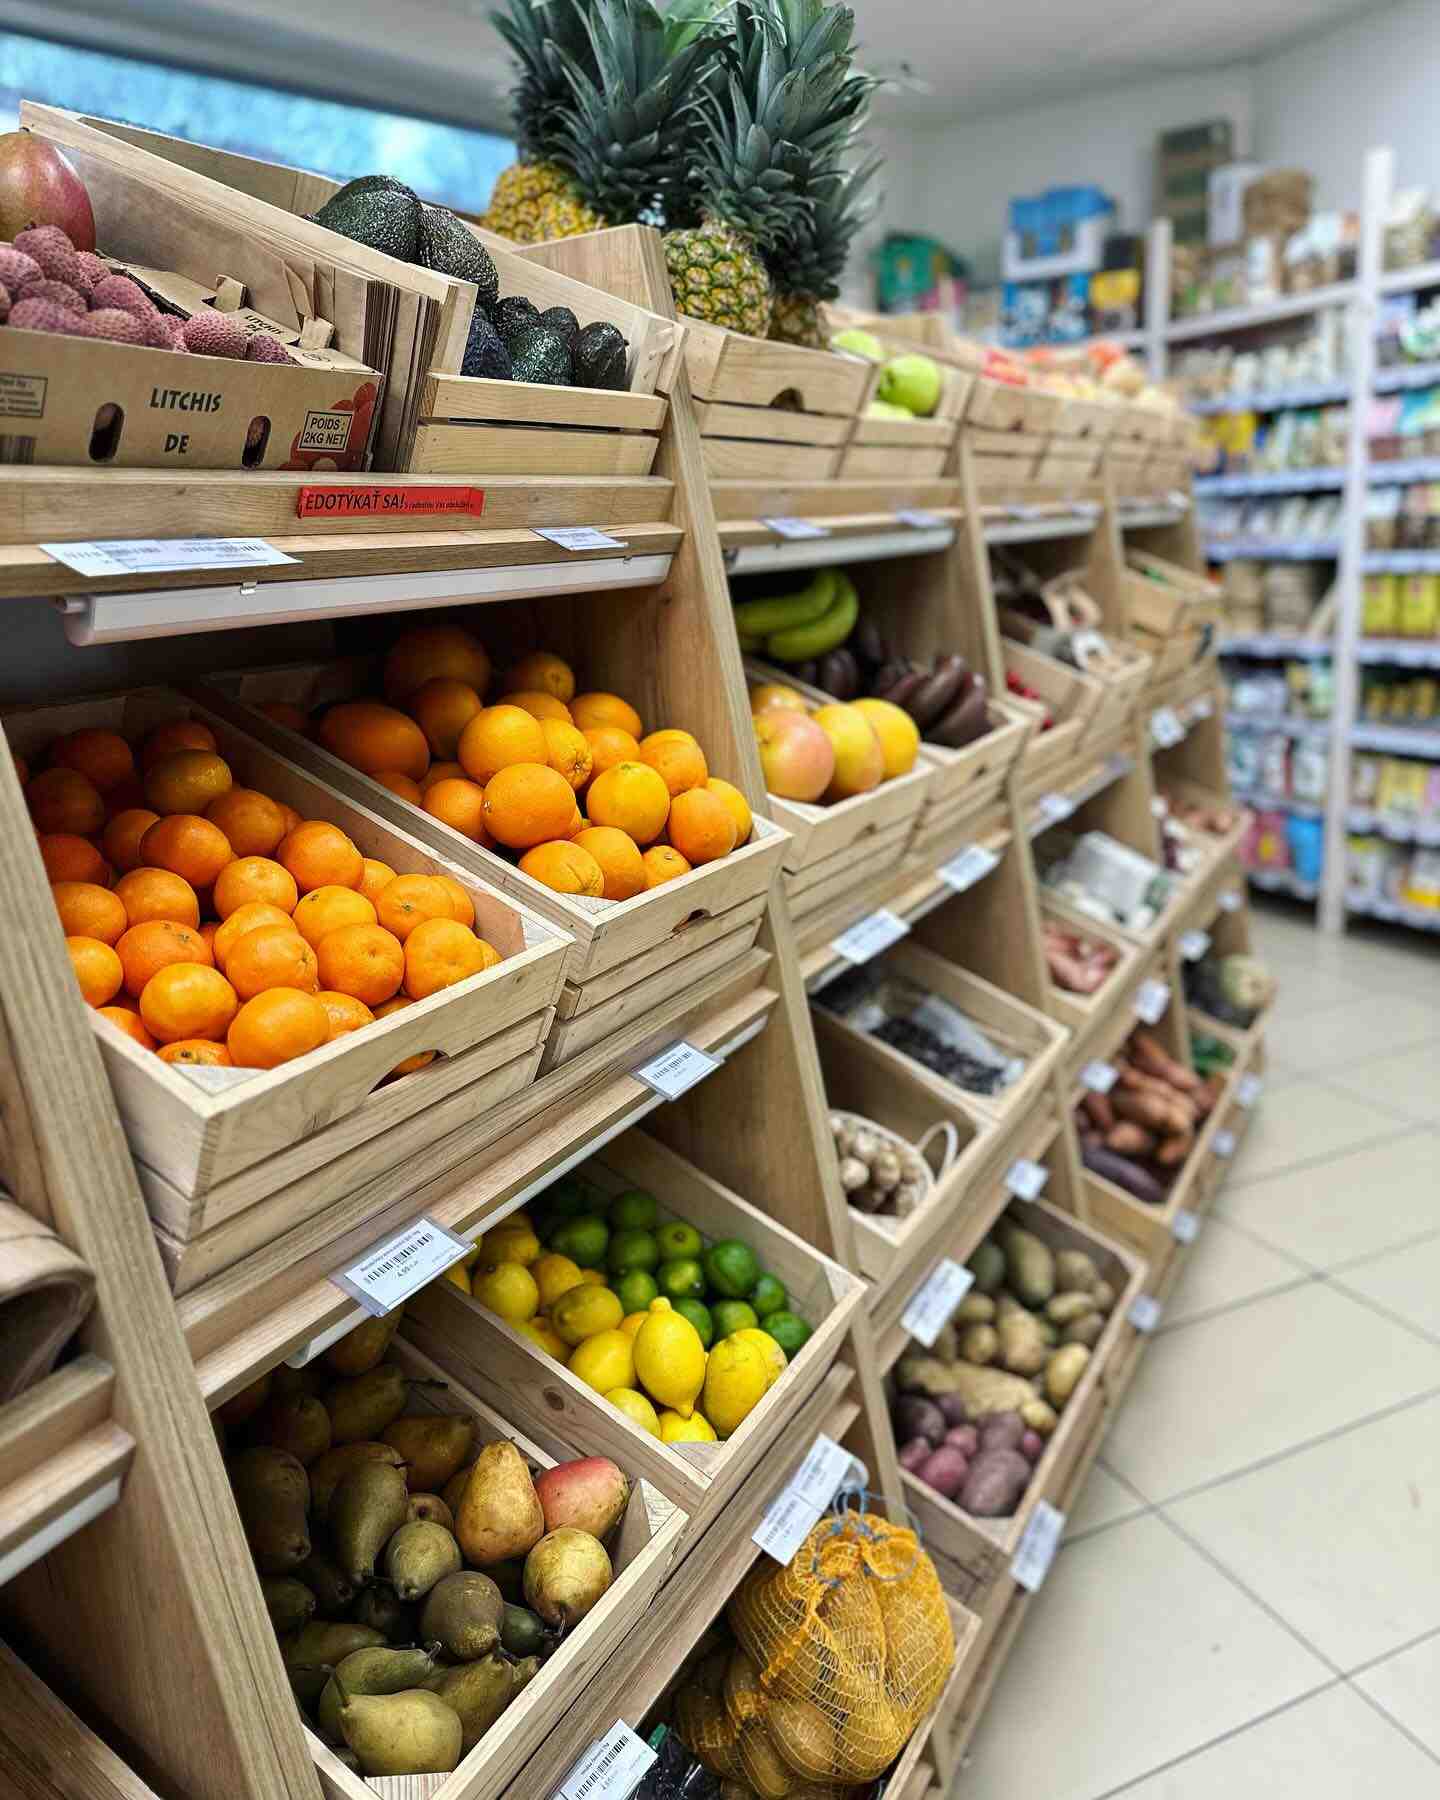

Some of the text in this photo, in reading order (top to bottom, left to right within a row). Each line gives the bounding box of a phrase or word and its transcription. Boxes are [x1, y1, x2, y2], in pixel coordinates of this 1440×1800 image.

[149, 387, 222, 413] LITCHIS
[164, 433, 190, 454] DE
[303, 431, 345, 445] 2KG NET
[383, 492, 405, 509] SA!
